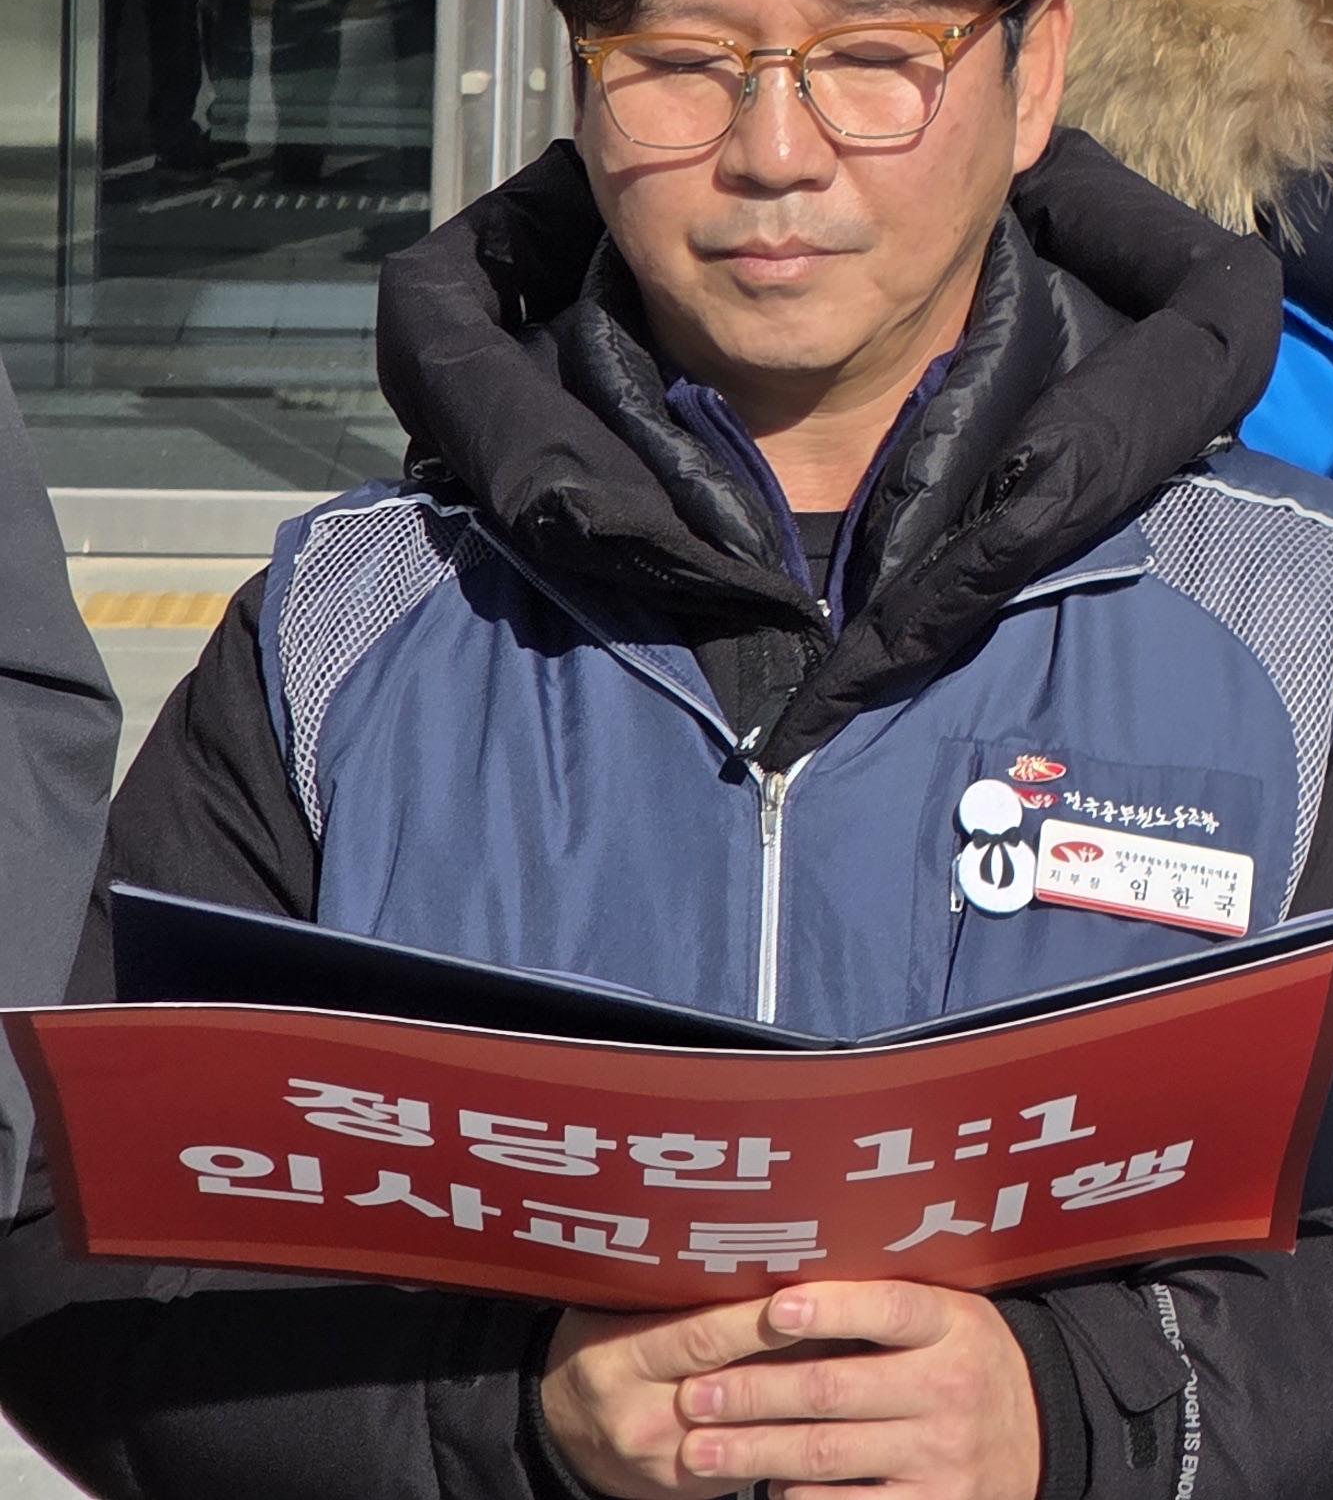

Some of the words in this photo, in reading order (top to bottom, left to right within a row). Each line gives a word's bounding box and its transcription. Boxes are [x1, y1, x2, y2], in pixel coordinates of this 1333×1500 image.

[1130, 879, 1236, 918] 임한국
[283, 1077, 791, 1190] 정당한
[846, 1094, 1097, 1182] 1:1
[179, 1145, 828, 1274] 인사교류
[883, 1139, 1194, 1252] 시행
[1184, 1431, 1201, 1451] IS
